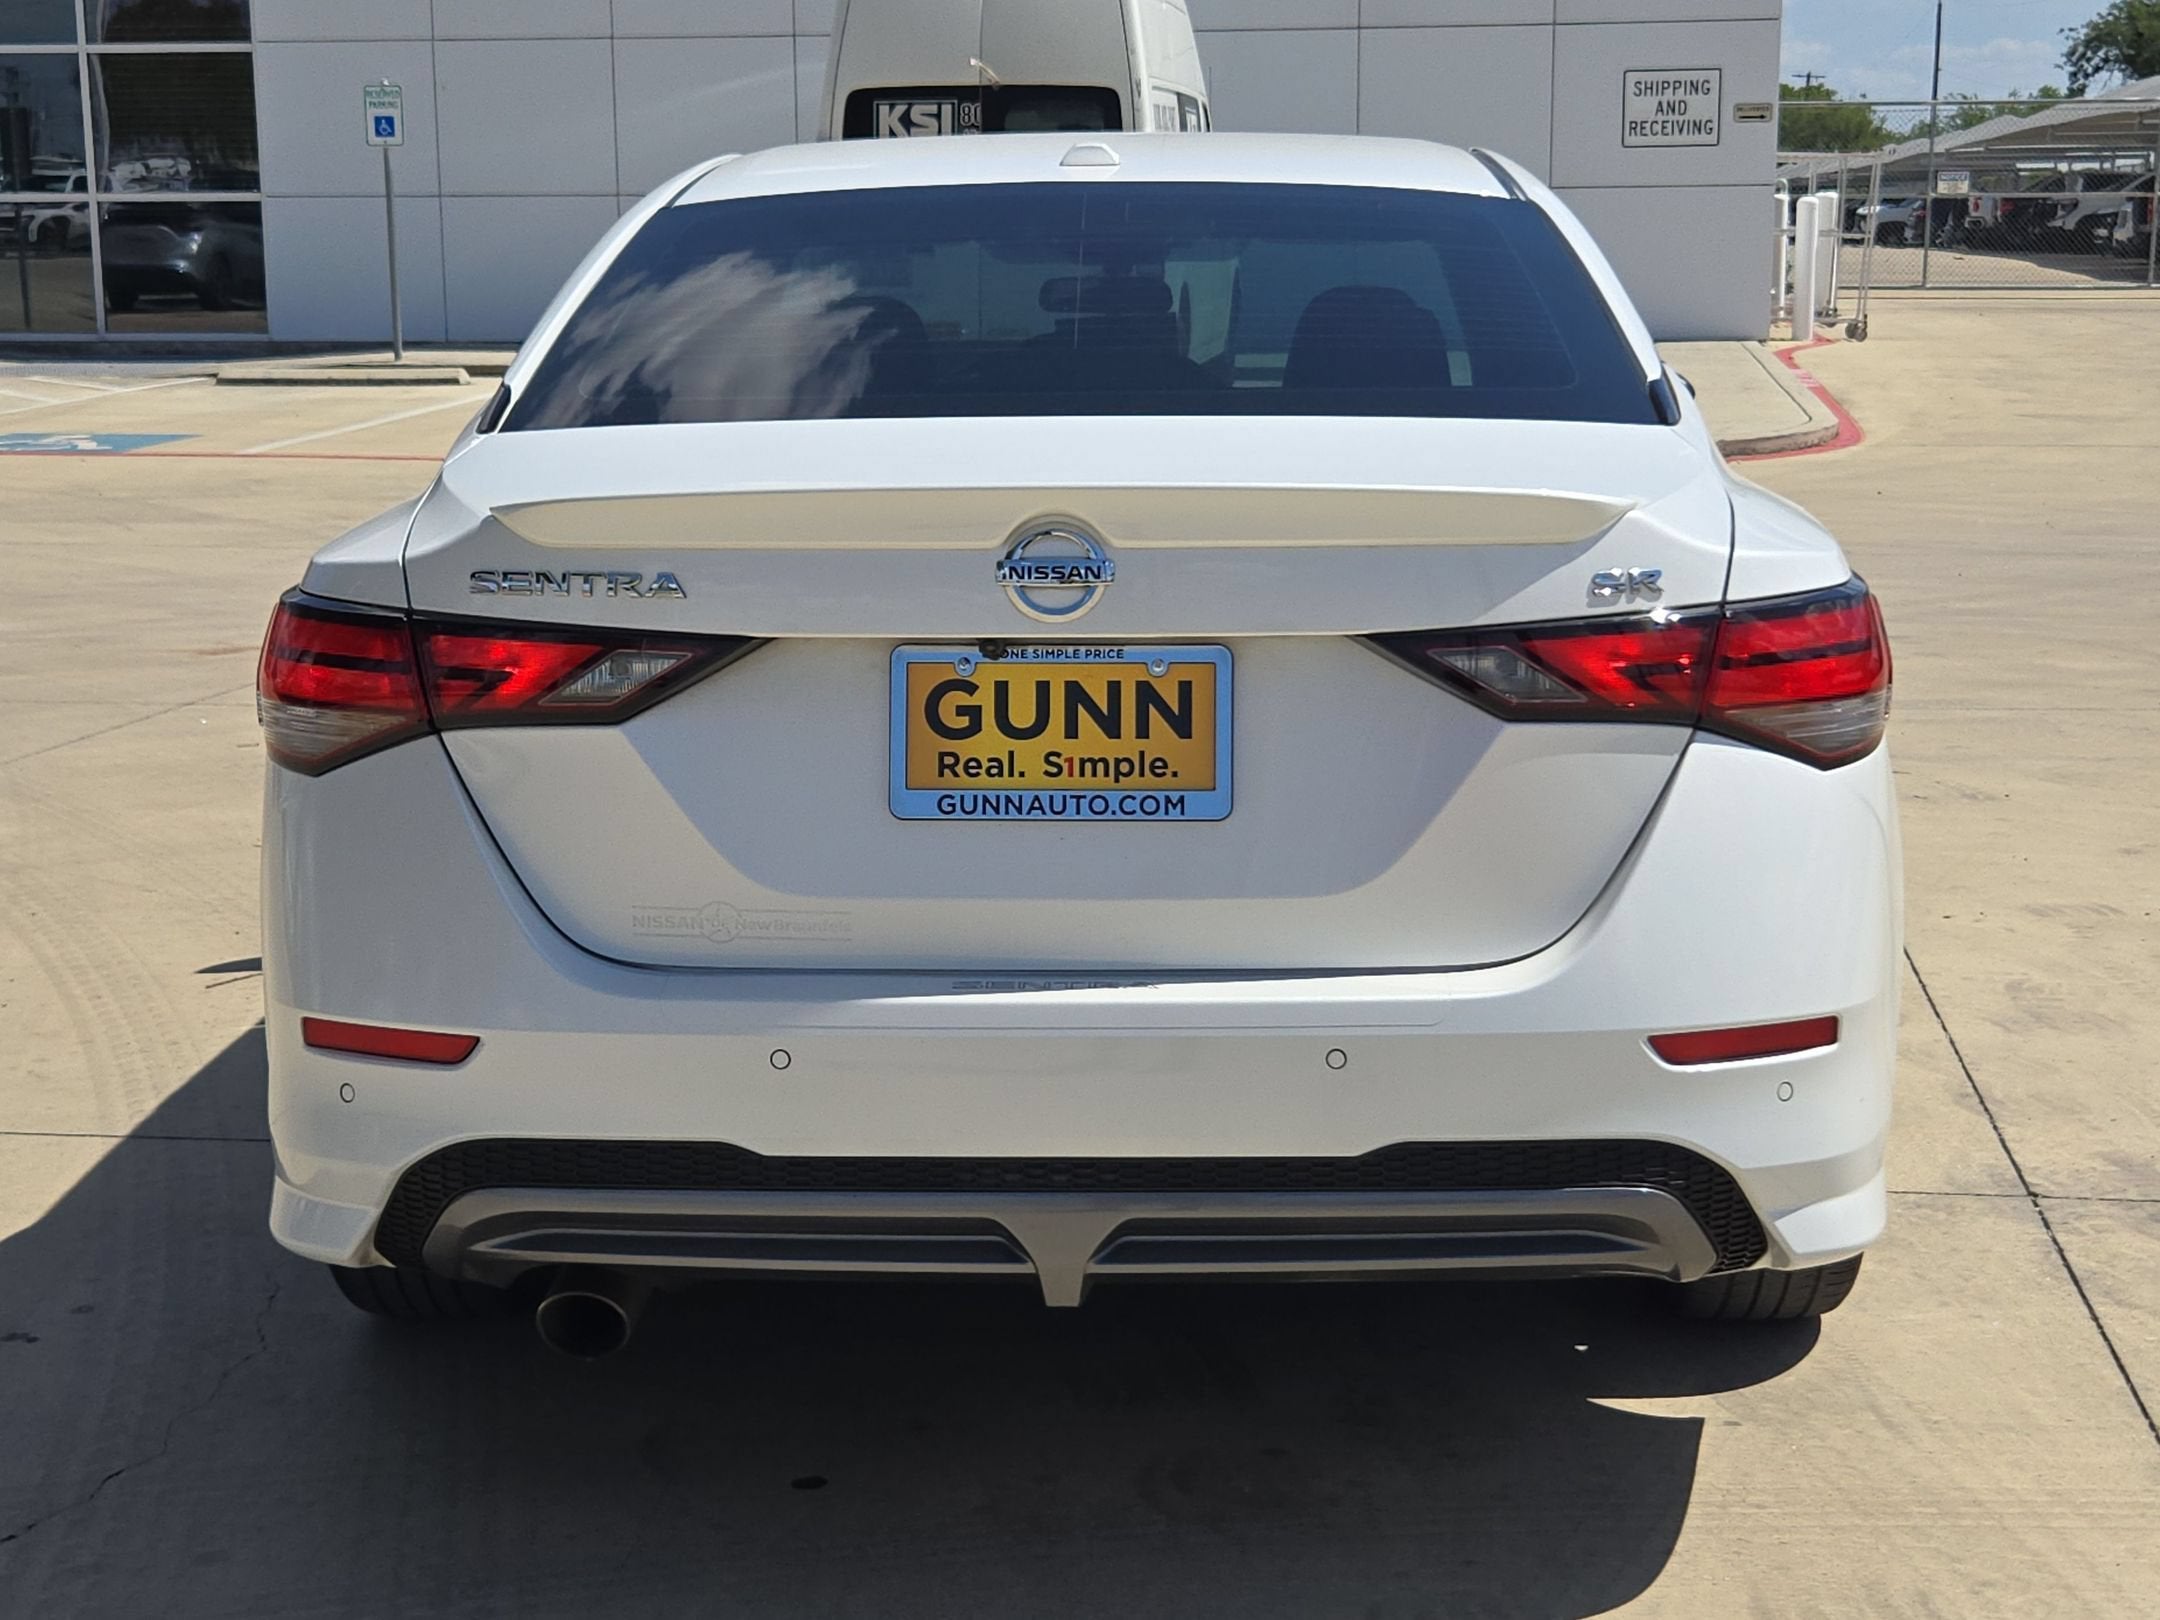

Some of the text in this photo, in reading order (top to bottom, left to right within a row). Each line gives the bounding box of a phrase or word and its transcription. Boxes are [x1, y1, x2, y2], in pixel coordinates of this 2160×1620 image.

[1633, 79, 1711, 97] SHIPPING
[1655, 100, 1687, 116] AND
[878, 103, 952, 138] KSI
[1628, 119, 1713, 137] RECEIVING
[1008, 565, 1102, 580] NISSAN
[1590, 567, 1664, 597] SR
[469, 570, 687, 599] SENTRA
[1000, 648, 1125, 659] ONE SIMPLE PRICE
[924, 678, 1193, 741] GUNN
[937, 751, 1025, 778] Real.
[936, 794, 1186, 816] GUNNAUTO.COM
[632, 914, 704, 929] NISSAN
